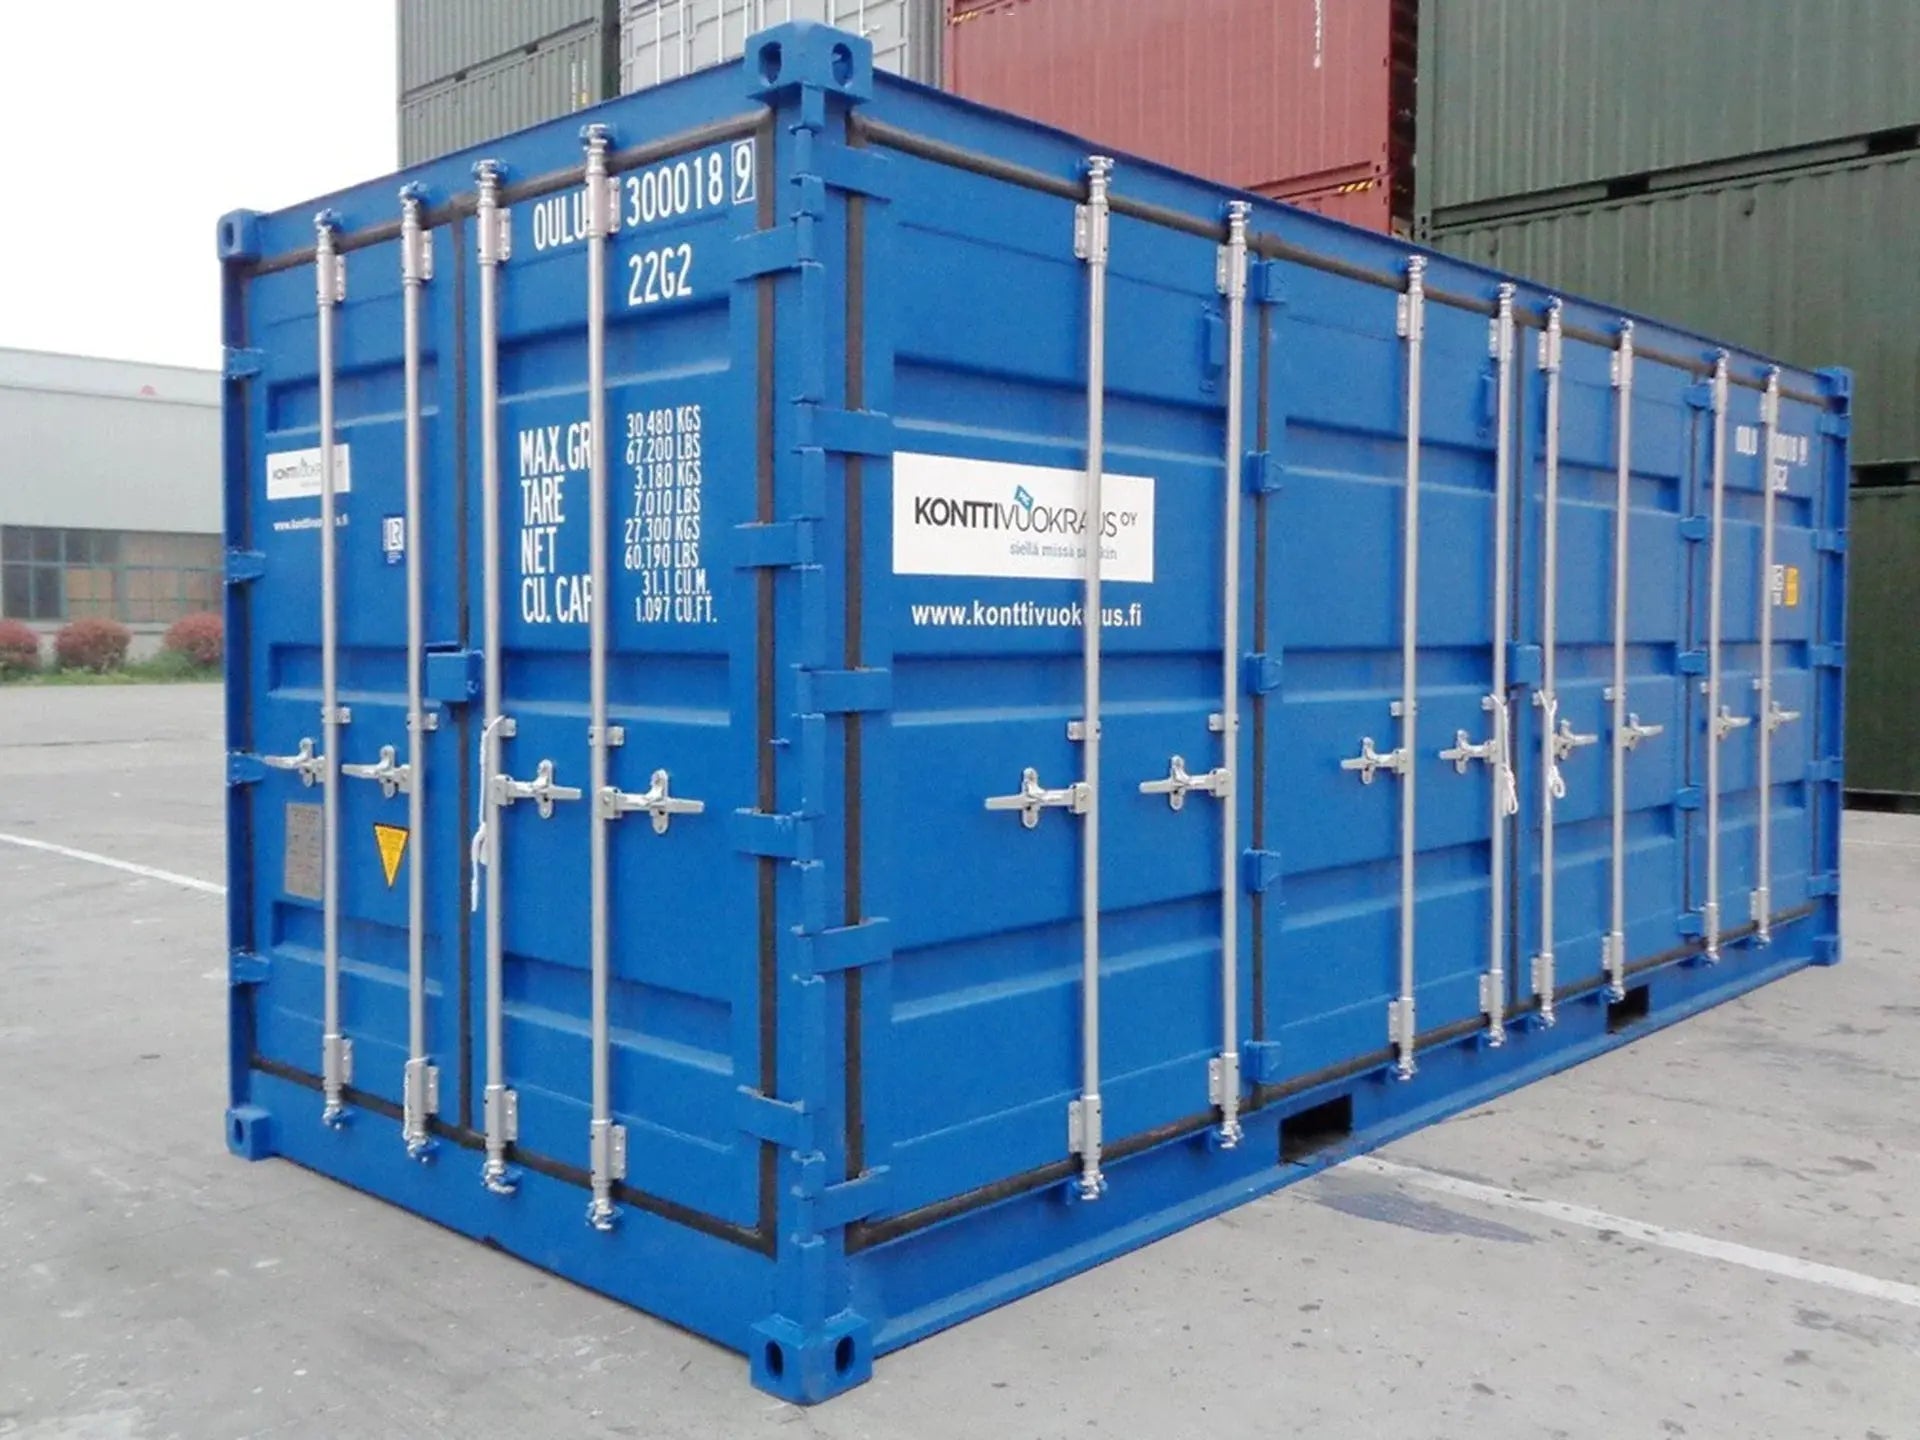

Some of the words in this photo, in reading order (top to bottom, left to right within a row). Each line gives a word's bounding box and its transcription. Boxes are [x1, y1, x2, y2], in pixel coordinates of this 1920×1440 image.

[533, 189, 587, 251] OULU
[626, 152, 724, 227] 300018
[735, 144, 752, 199] 9
[628, 243, 692, 306] 22G2
[626, 408, 673, 438] 30.480
[677, 405, 701, 433] KGS
[520, 425, 566, 477] MAX.
[626, 436, 673, 465] 67.200
[677, 433, 701, 460] LBS
[677, 461, 702, 487] KGS
[521, 475, 565, 526] TARE
[677, 488, 701, 514] LBS
[675, 515, 700, 541] KGS
[521, 528, 557, 575] NET
[674, 542, 699, 568] LBS
[642, 569, 670, 595] 31.1
[522, 577, 552, 623] CU.
[911, 600, 1142, 627] www.konttivuokus.fi
